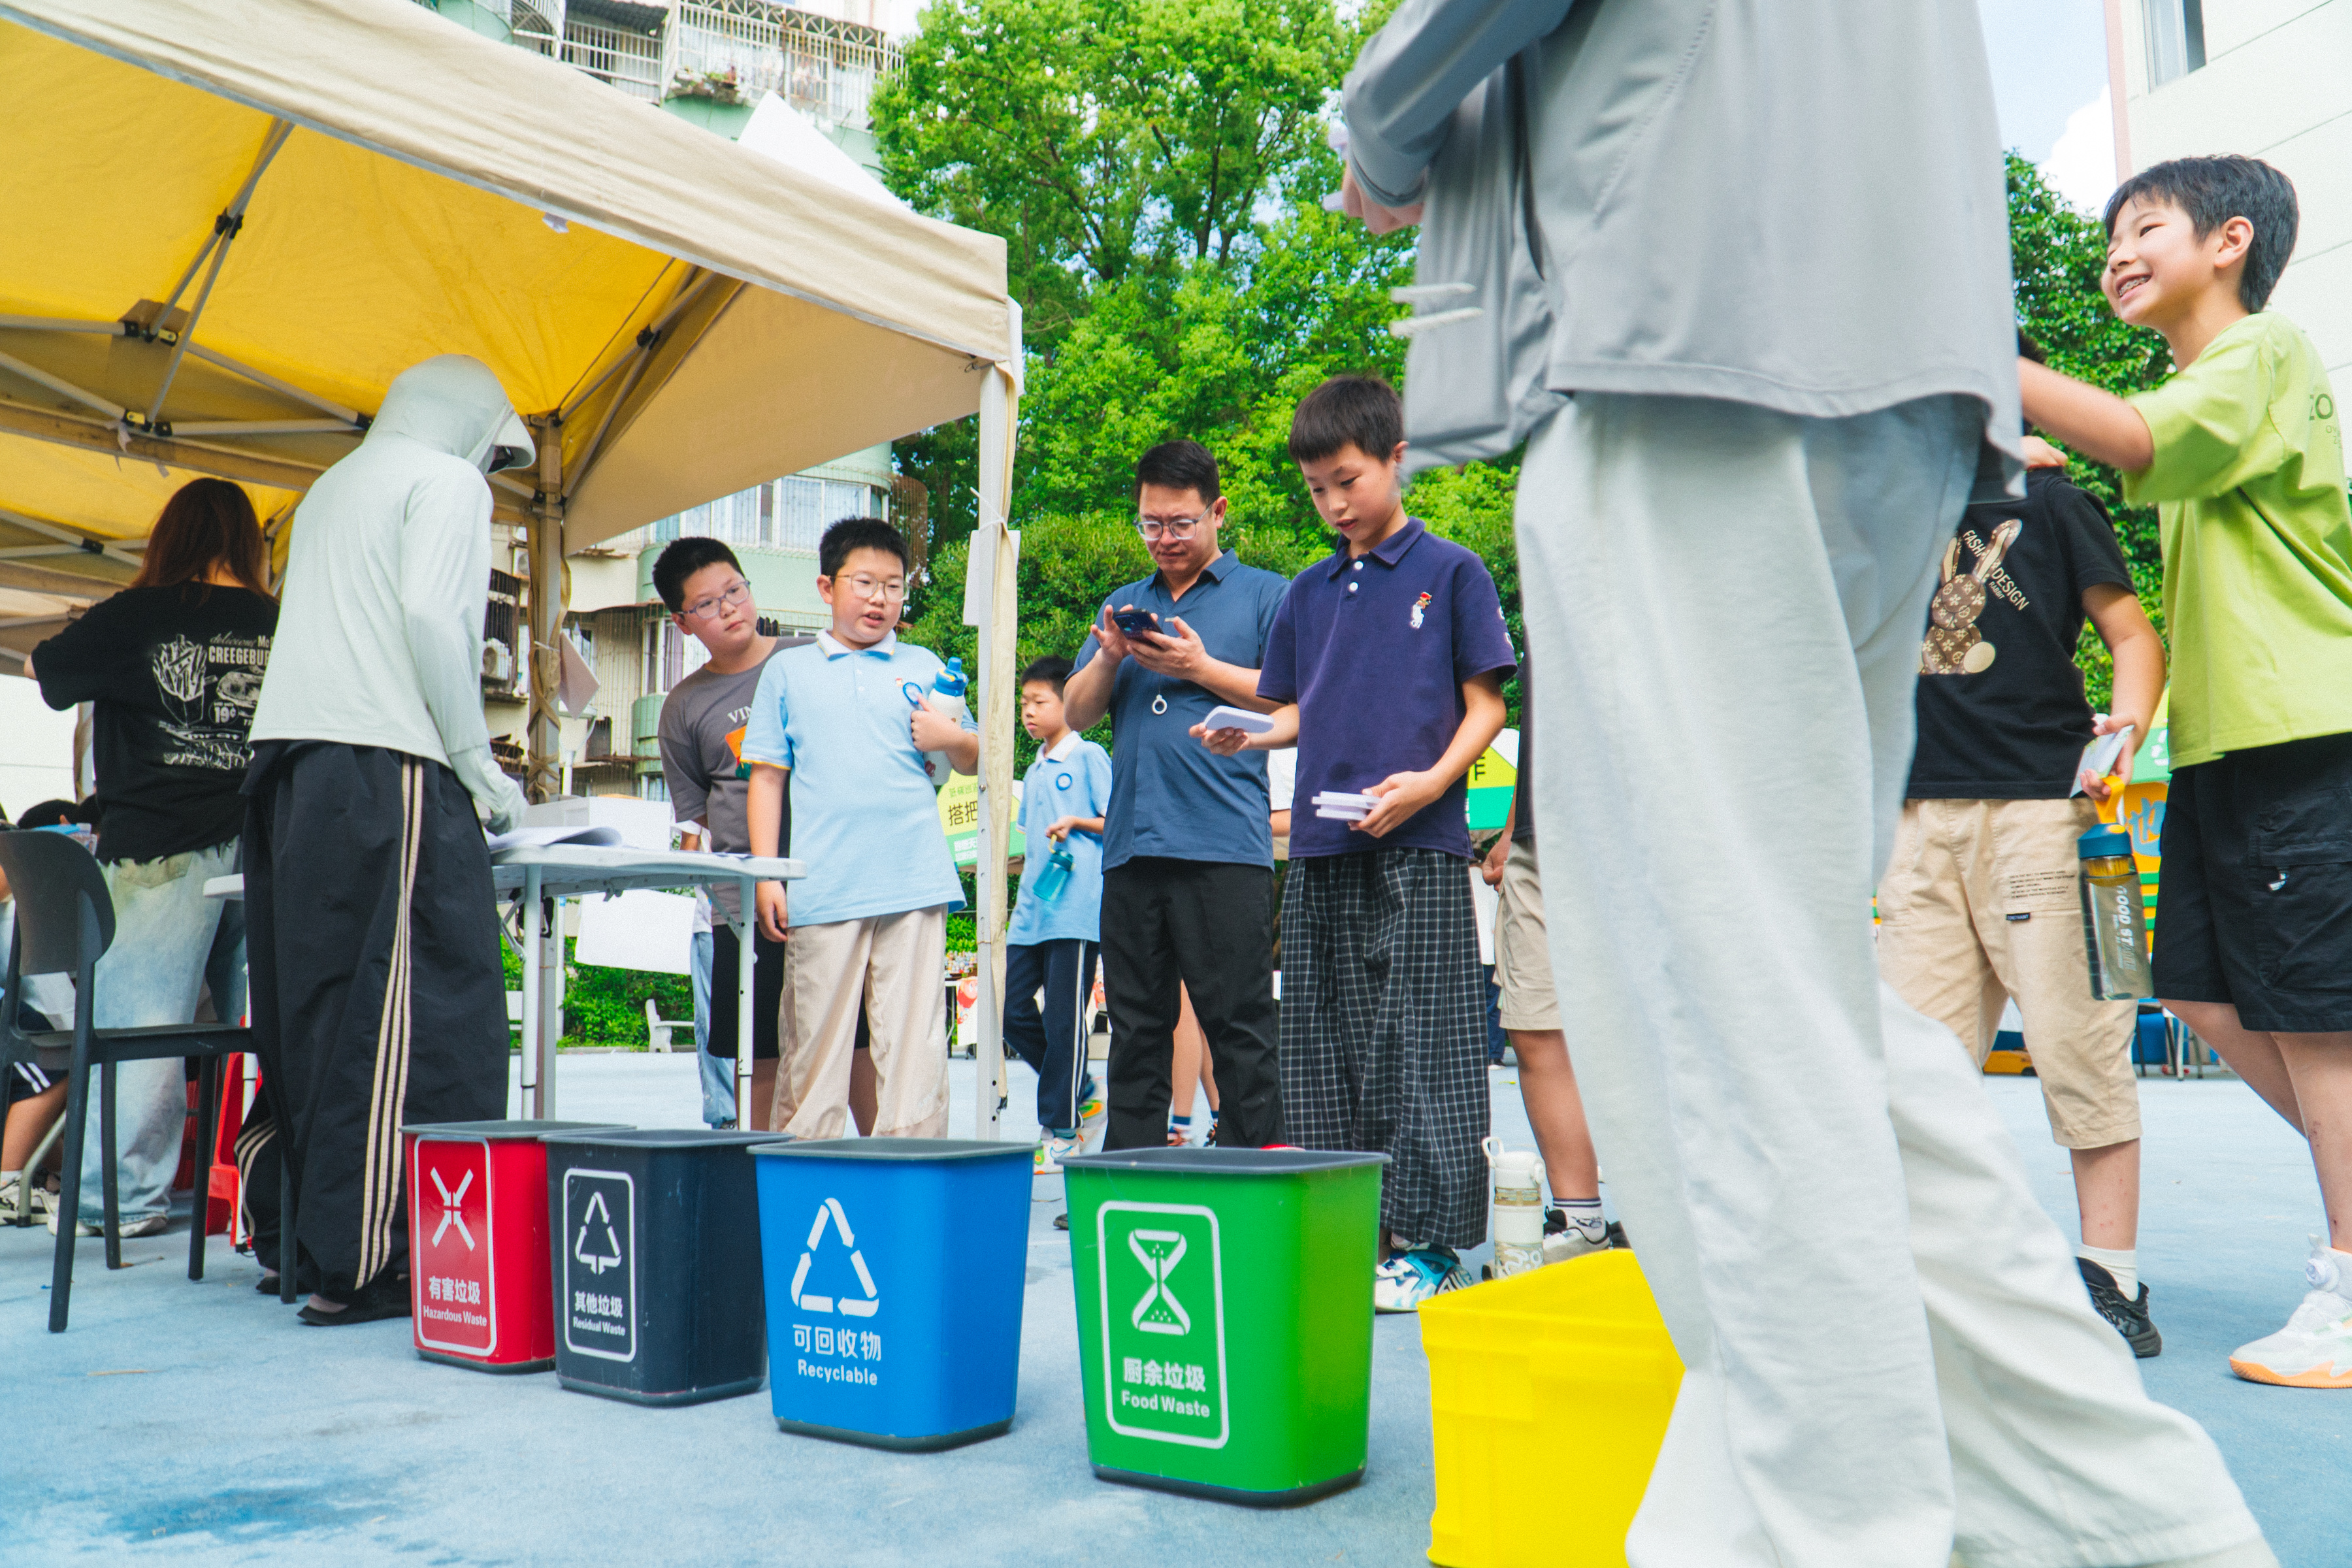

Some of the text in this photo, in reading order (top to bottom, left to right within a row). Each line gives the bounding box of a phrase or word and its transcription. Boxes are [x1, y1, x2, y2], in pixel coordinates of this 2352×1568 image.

[1989, 581, 2005, 600] RABBIT
[1991, 567, 2030, 611] DESIGN
[429, 1275, 480, 1305] 有害垃圾
[575, 1290, 623, 1318] 其他垃圾
[423, 1305, 487, 1327] Hazardous Waste
[573, 1316, 625, 1336] Residual Waste
[792, 1324, 881, 1361] 可回收物
[798, 1359, 877, 1386] Recyclable
[1123, 1356, 1206, 1392] 厨余垃圾
[1121, 1389, 1210, 1418] Food Waste
